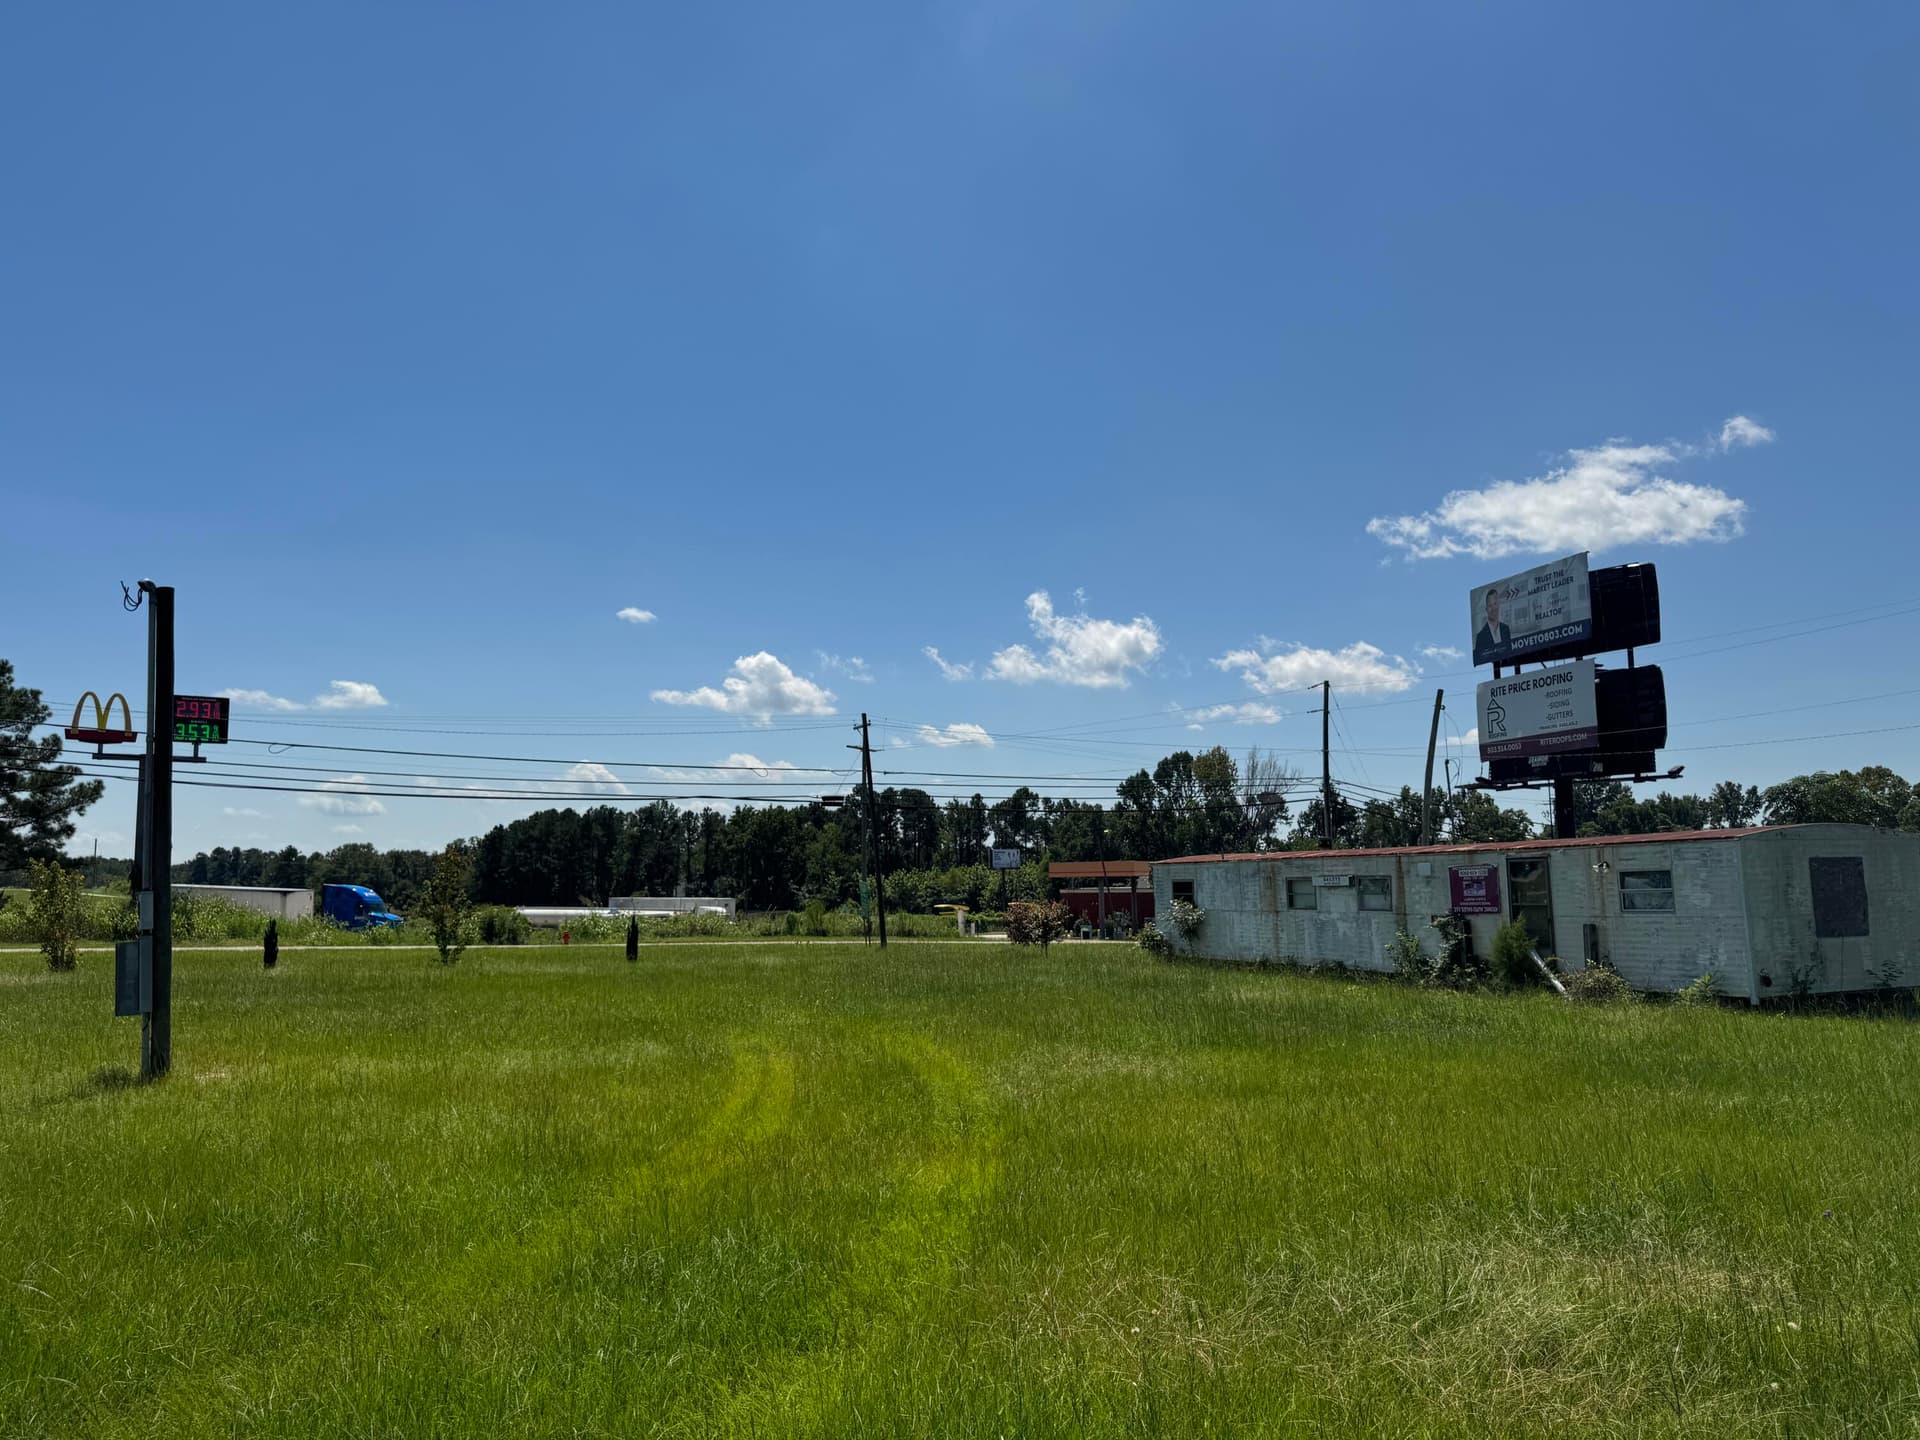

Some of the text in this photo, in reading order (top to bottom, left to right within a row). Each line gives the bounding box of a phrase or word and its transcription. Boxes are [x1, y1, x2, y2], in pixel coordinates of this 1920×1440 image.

[1528, 576, 1574, 595] MARKET LEADER
[1534, 569, 1564, 584] TRUST THE
[1511, 624, 1583, 650] MOVETO803.COM
[1490, 672, 1574, 698] RITE PRICE ROOFING
